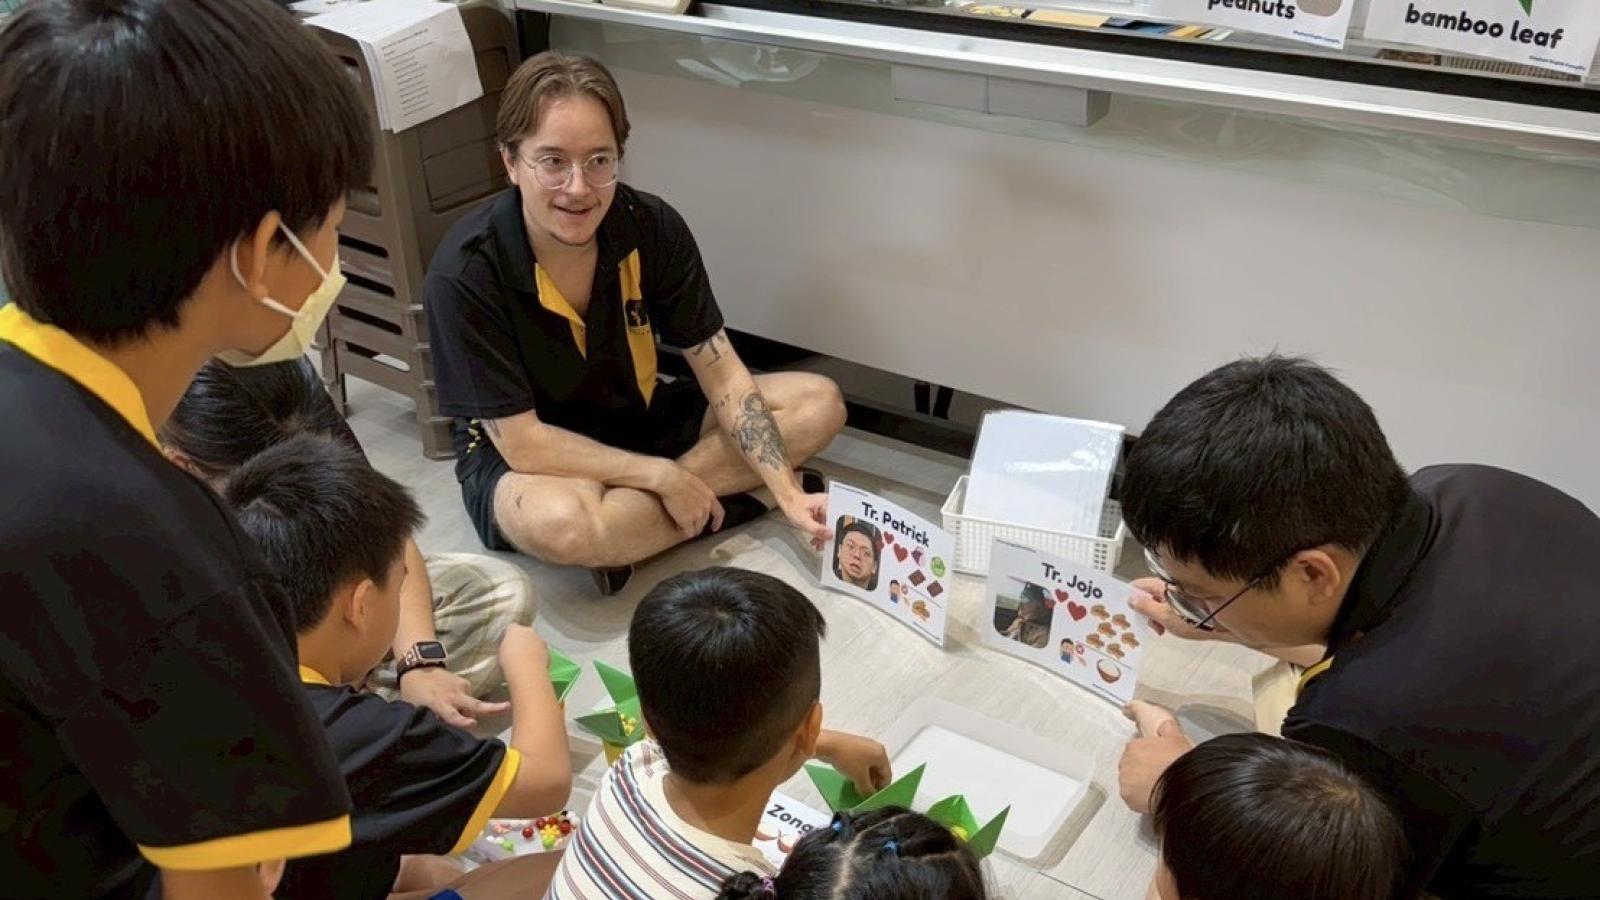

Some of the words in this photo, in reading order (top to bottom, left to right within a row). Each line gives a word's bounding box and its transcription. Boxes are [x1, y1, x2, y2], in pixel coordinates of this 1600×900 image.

[1208, 0, 1295, 19] peanuts
[1405, 3, 1503, 38] bamboo
[1510, 20, 1564, 49] leaf
[862, 501, 879, 521] Tr.
[883, 510, 929, 548] Patrick
[1042, 562, 1062, 584] Tr.
[1066, 574, 1103, 599] Jojo
